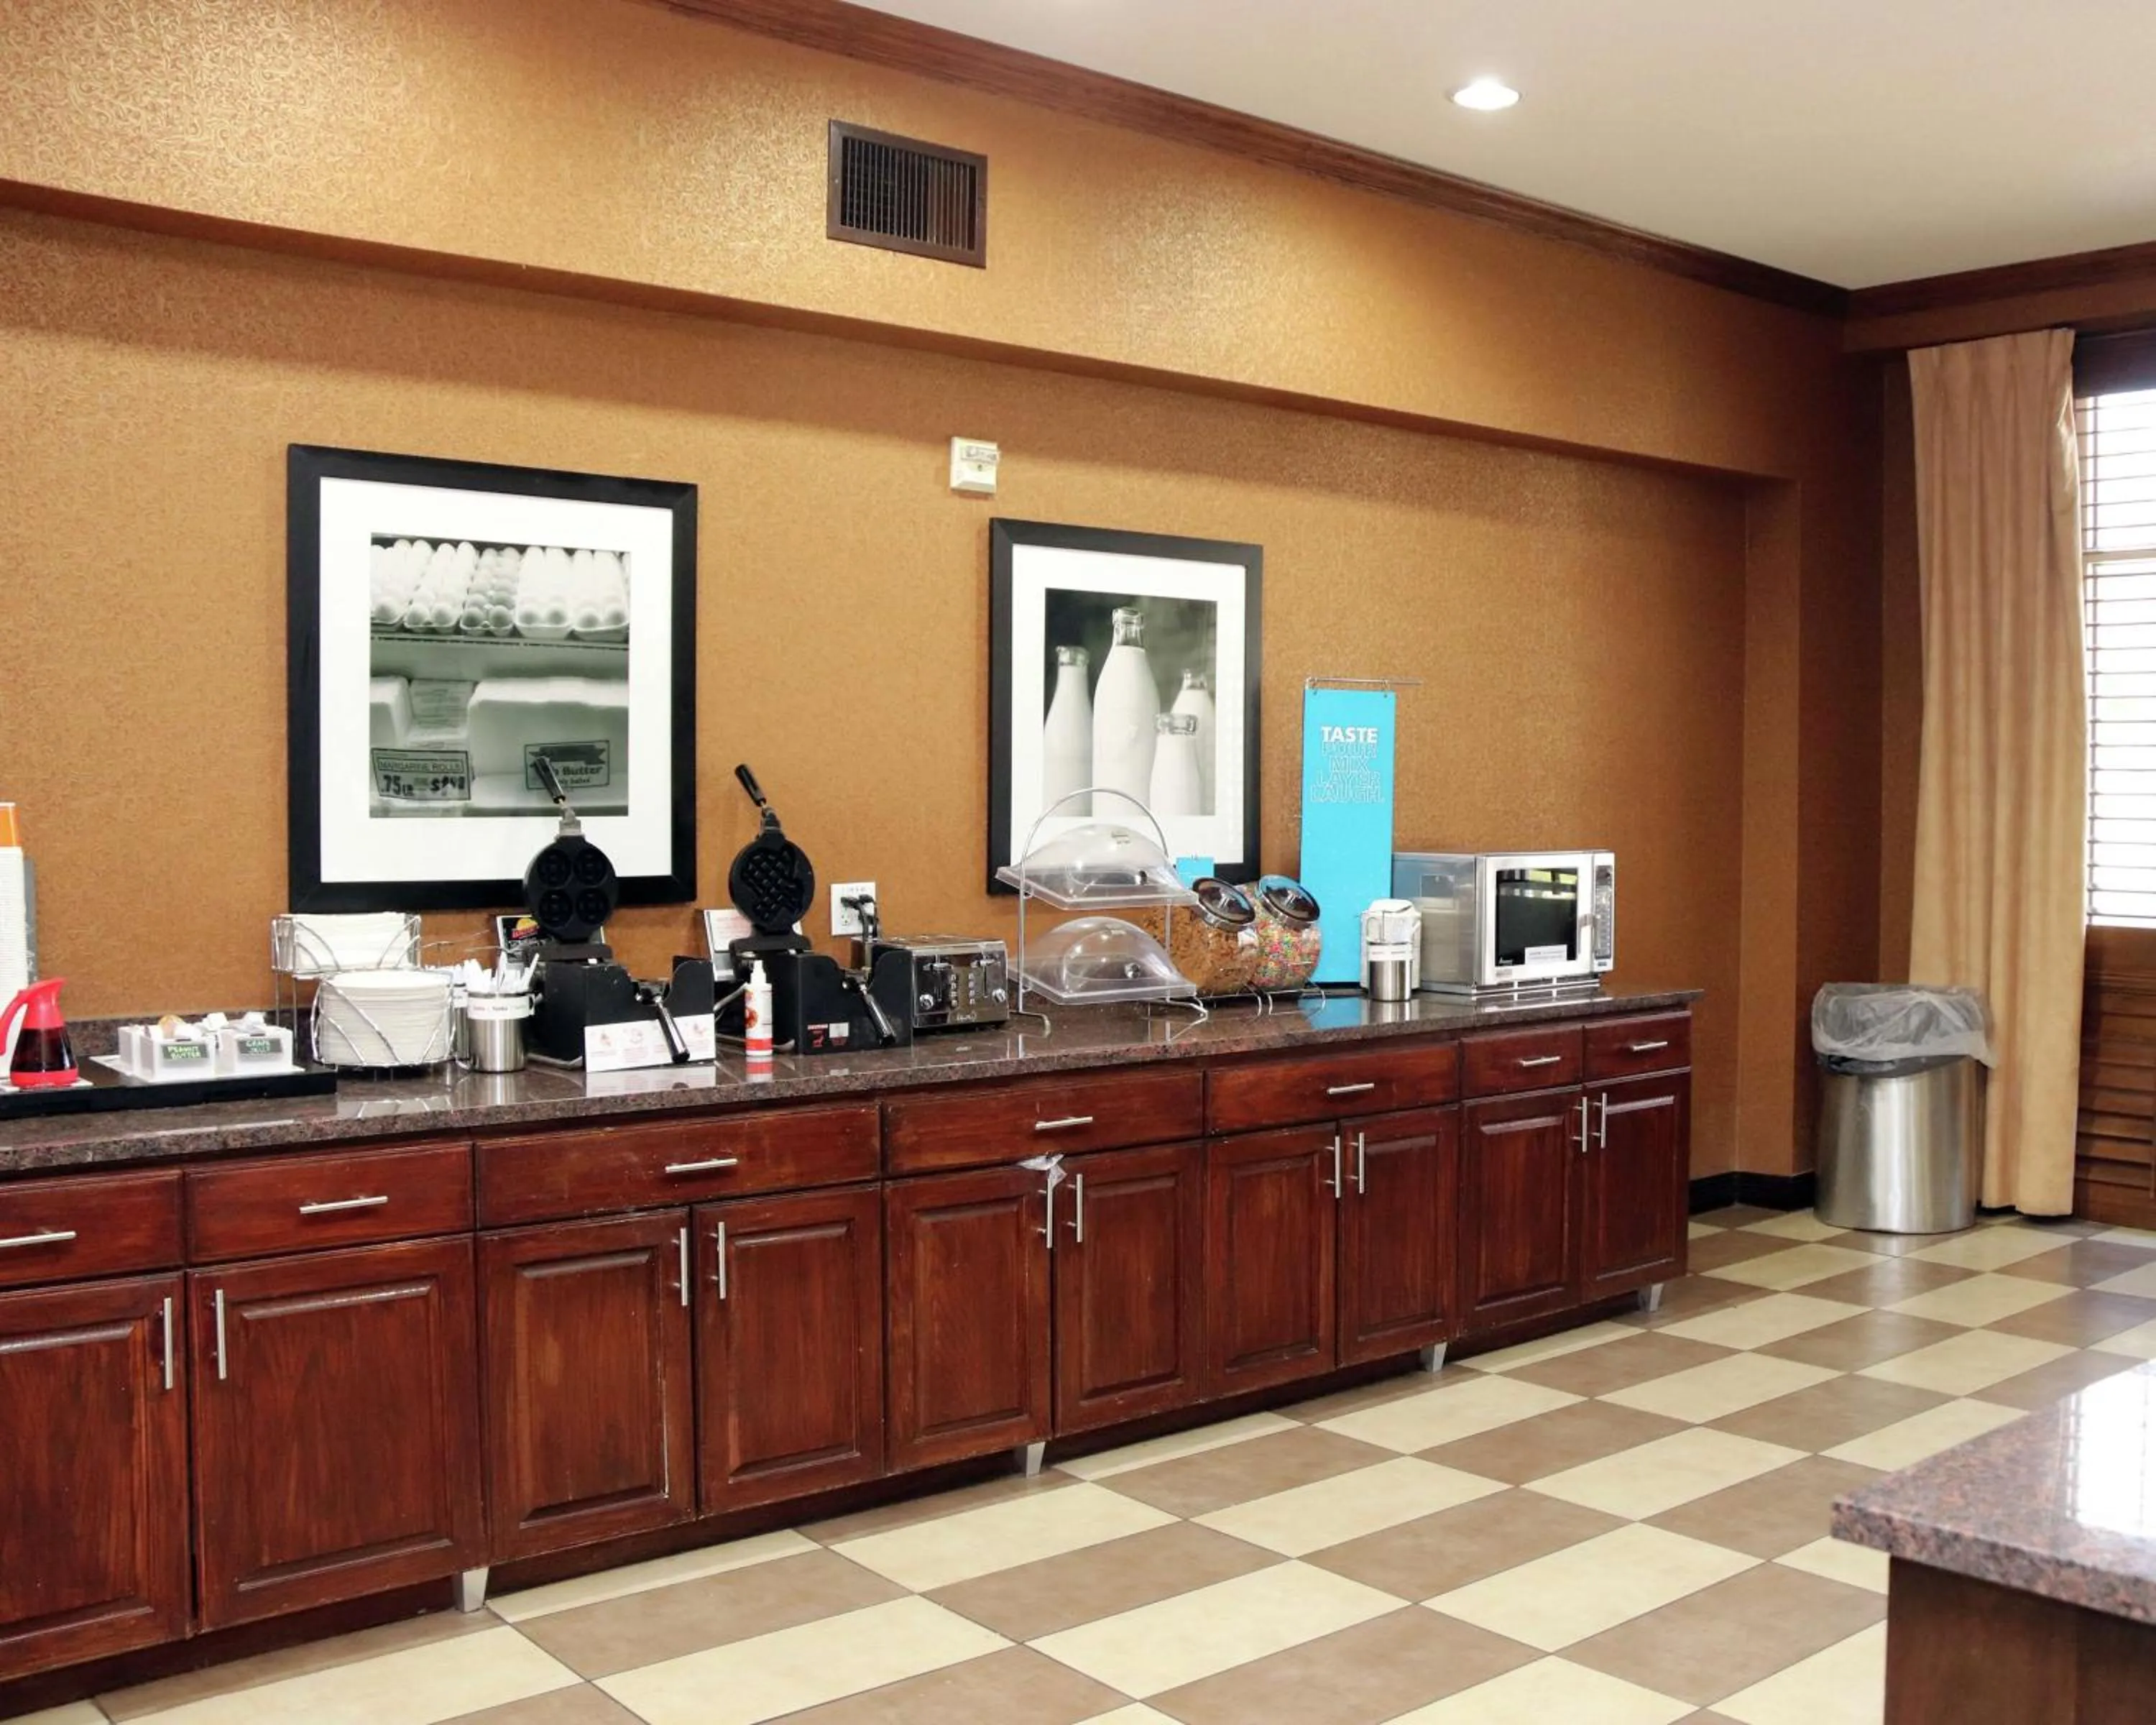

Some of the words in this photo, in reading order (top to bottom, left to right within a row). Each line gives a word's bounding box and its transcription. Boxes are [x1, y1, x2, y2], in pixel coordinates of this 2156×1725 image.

[1321, 726, 1378, 743] TASTE
[563, 765, 603, 776] Butter
[1330, 755, 1370, 773] MIX
[1317, 770, 1381, 788] LAYER
